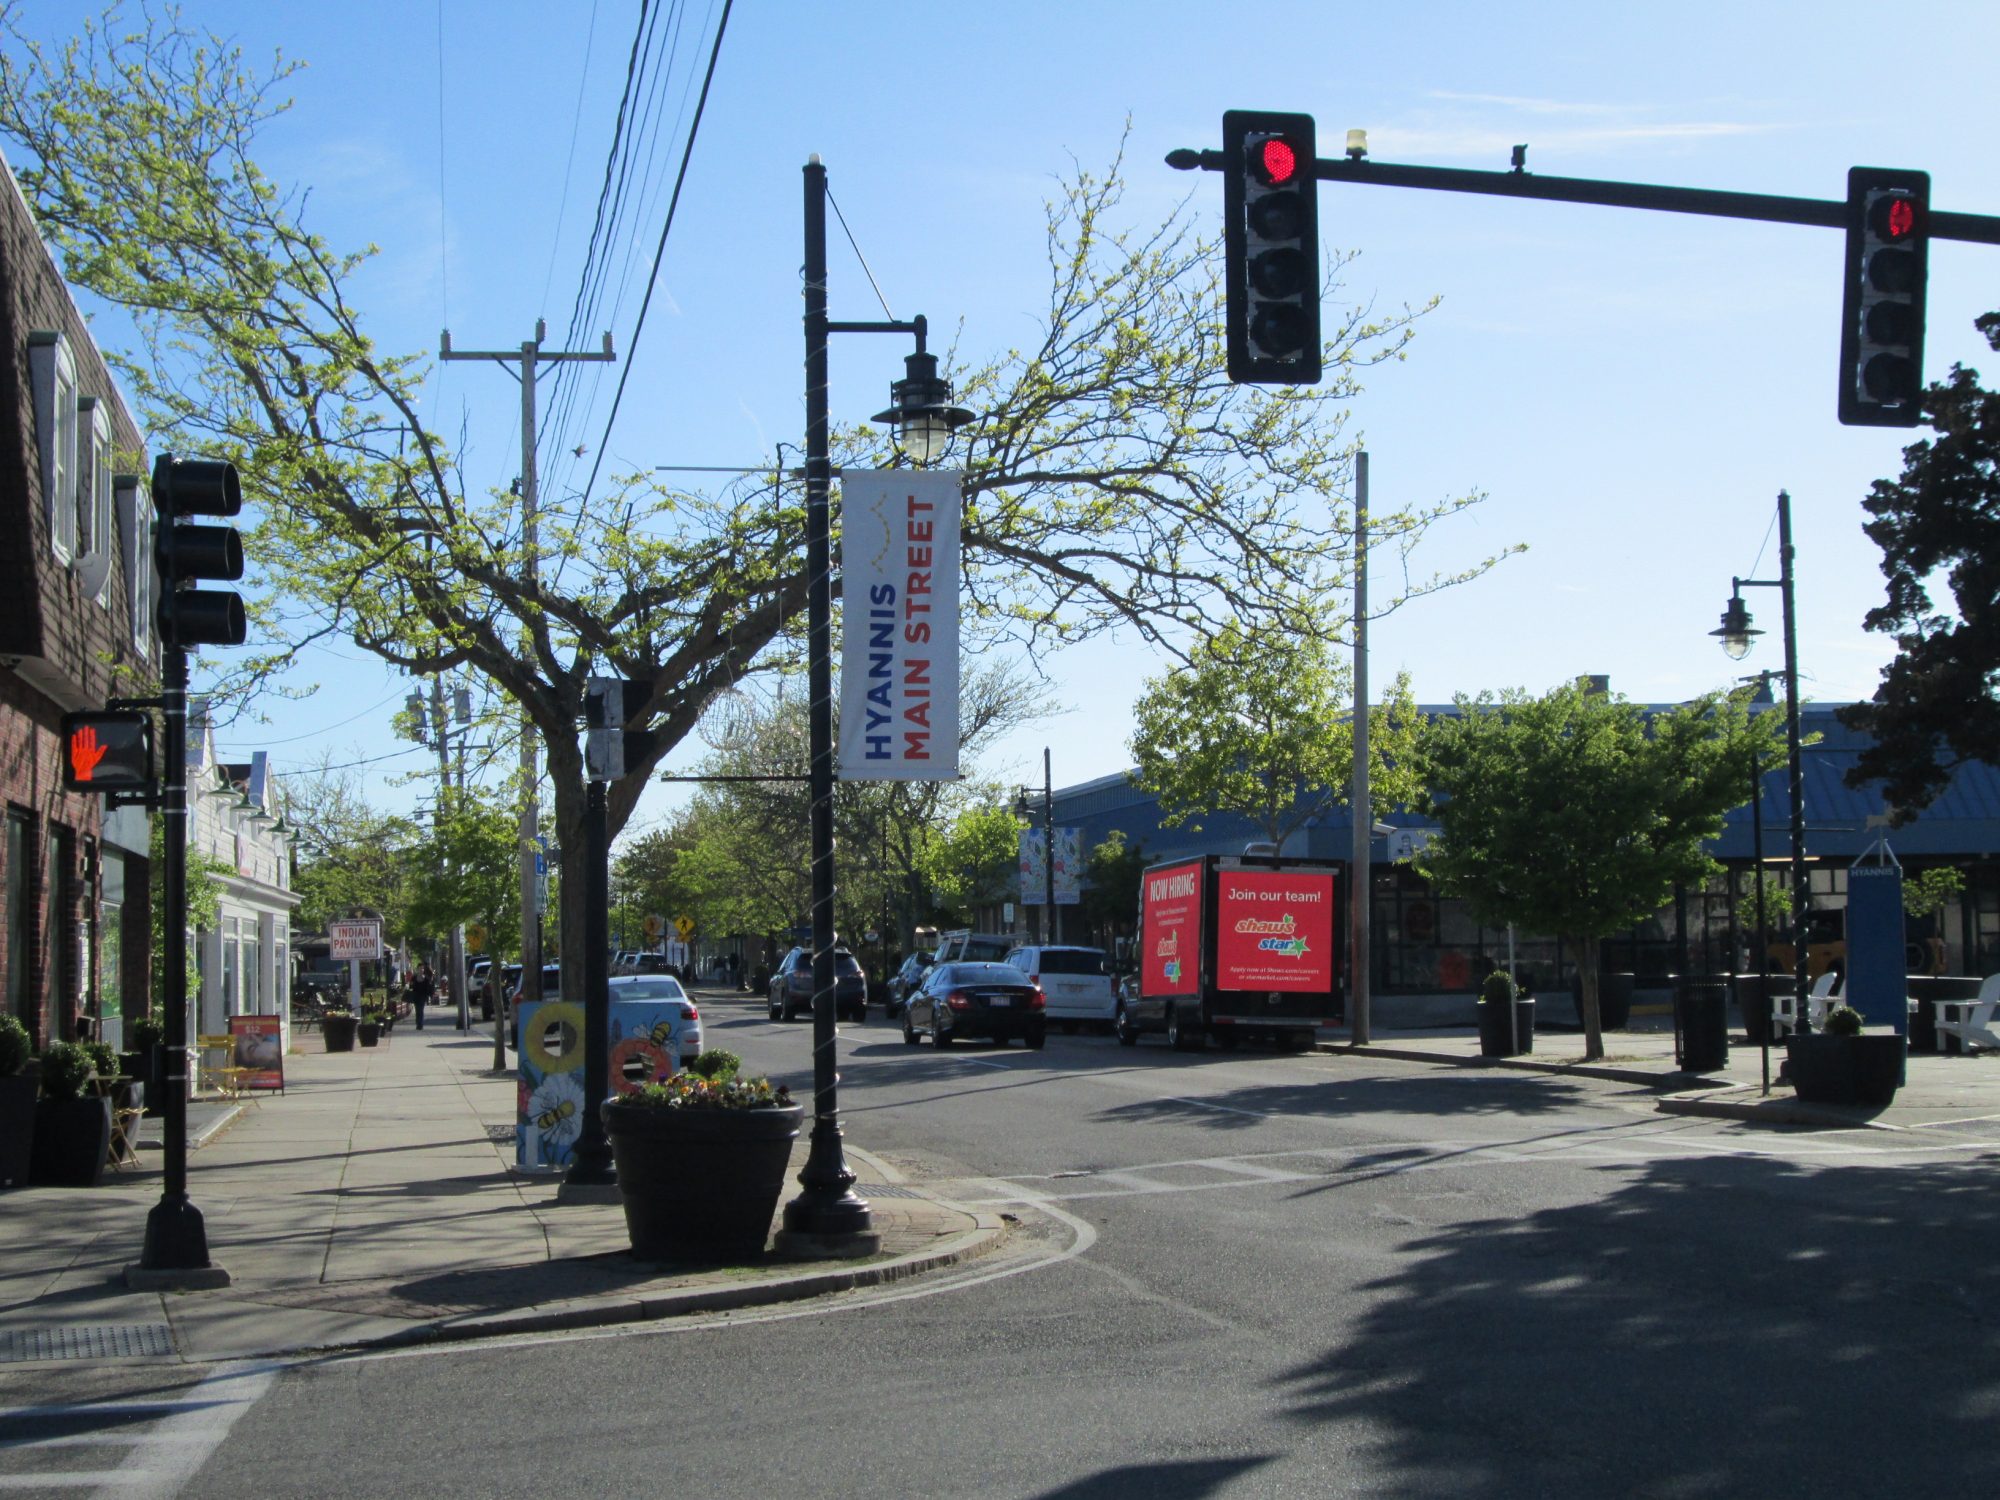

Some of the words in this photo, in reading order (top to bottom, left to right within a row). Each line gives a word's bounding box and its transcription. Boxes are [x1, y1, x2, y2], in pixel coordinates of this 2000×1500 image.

[905, 496, 934, 644] STREET
[865, 583, 897, 760] HYANNIS
[904, 659, 932, 760] MAIN
[1150, 878, 1168, 902] NOW
[1169, 872, 1195, 899] HIRING
[1228, 888, 1256, 901] Join
[1259, 891, 1282, 902] our
[1285, 891, 1321, 902] team!
[338, 927, 370, 937] INDIAN
[333, 938, 375, 949] PAVILION
[1258, 937, 1294, 951] star
